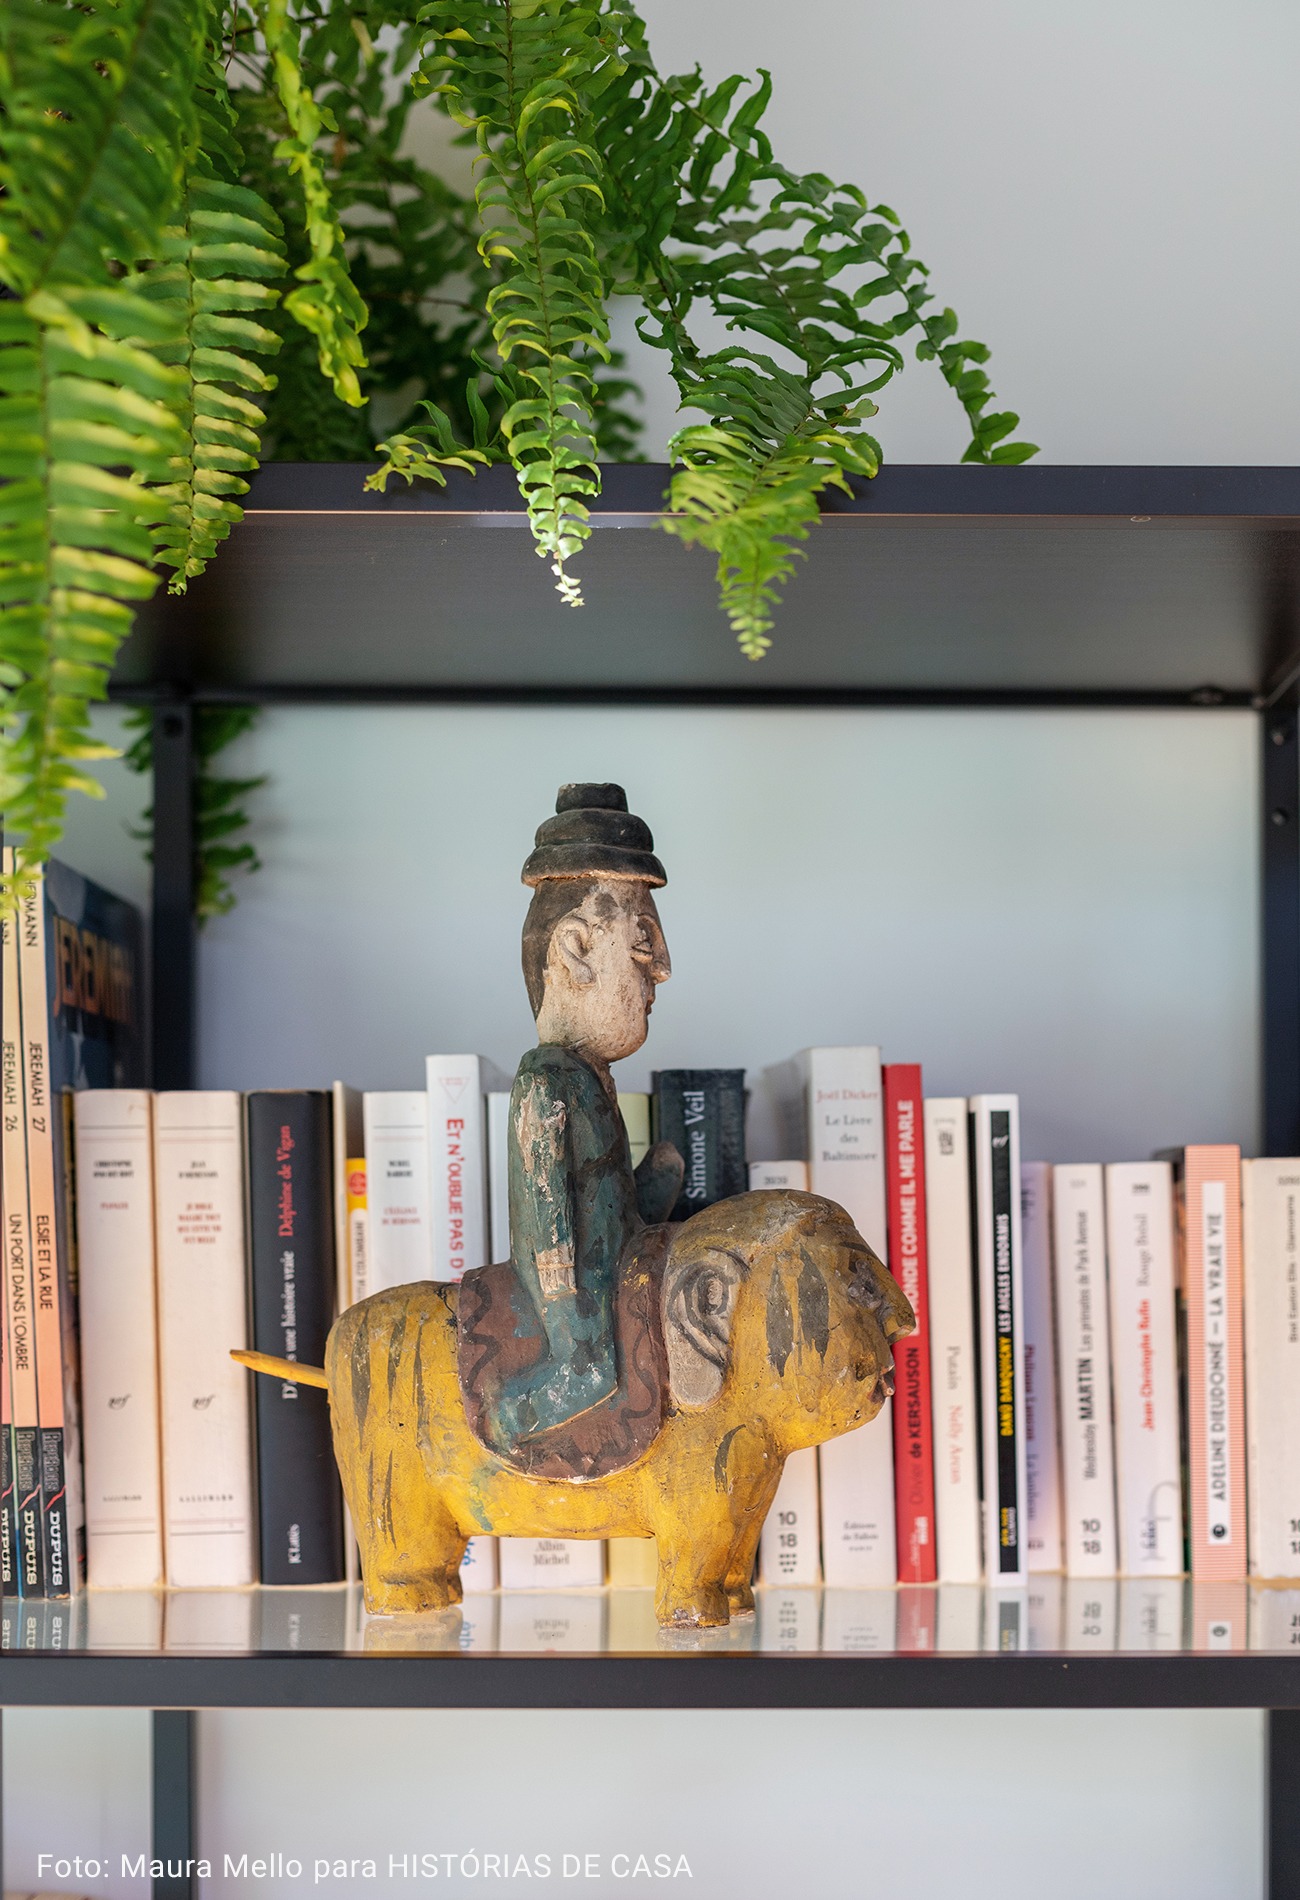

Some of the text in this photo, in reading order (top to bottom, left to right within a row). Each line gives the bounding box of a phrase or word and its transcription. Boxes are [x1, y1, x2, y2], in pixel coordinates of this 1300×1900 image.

[4, 1041, 18, 1132] JEREMIAH 26
[30, 1042, 46, 1133] JEREMIAH 27
[825, 1115, 839, 1126] Le
[897, 1100, 915, 1152] PARLE
[683, 1091, 706, 1199] Simone Veil
[899, 1154, 915, 1178] ME
[276, 1125, 297, 1237] Delphine de Vigan
[899, 1179, 916, 1195] IL
[449, 1219, 464, 1251] PAS
[900, 1196, 918, 1256] COMME
[1207, 1215, 1221, 1237] VIE
[36, 1214, 53, 1310] ELSIE ET LA RUE
[279, 1251, 295, 1280] vraie
[996, 1213, 1011, 1332] LES AIGLES ENDORMIS
[1208, 1245, 1222, 1290] VRAIE
[9, 1214, 28, 1371] UN PORT DANS L'OMBRE
[280, 1281, 296, 1327] histoire
[1209, 1297, 1223, 1316] LA
[285, 1328, 297, 1352] une
[998, 1336, 1014, 1403] DANQUIGNY
[1077, 1357, 1095, 1420] MARTIN
[1208, 1341, 1226, 1433] DIEUDONNÉ
[906, 1347, 921, 1439] KERSAUSON
[909, 1442, 923, 1459] de
[1211, 1439, 1227, 1500] ADELINE
[778, 1511, 797, 1525] 10
[778, 1534, 798, 1548] 18
[1082, 1519, 1101, 1532] 10
[24, 1510, 37, 1586] DUPUIS
[50, 1511, 63, 1587] DUPUIS
[533, 1554, 570, 1566] Michel
[536, 1541, 566, 1551] Albin
[1083, 1541, 1101, 1554] 18
